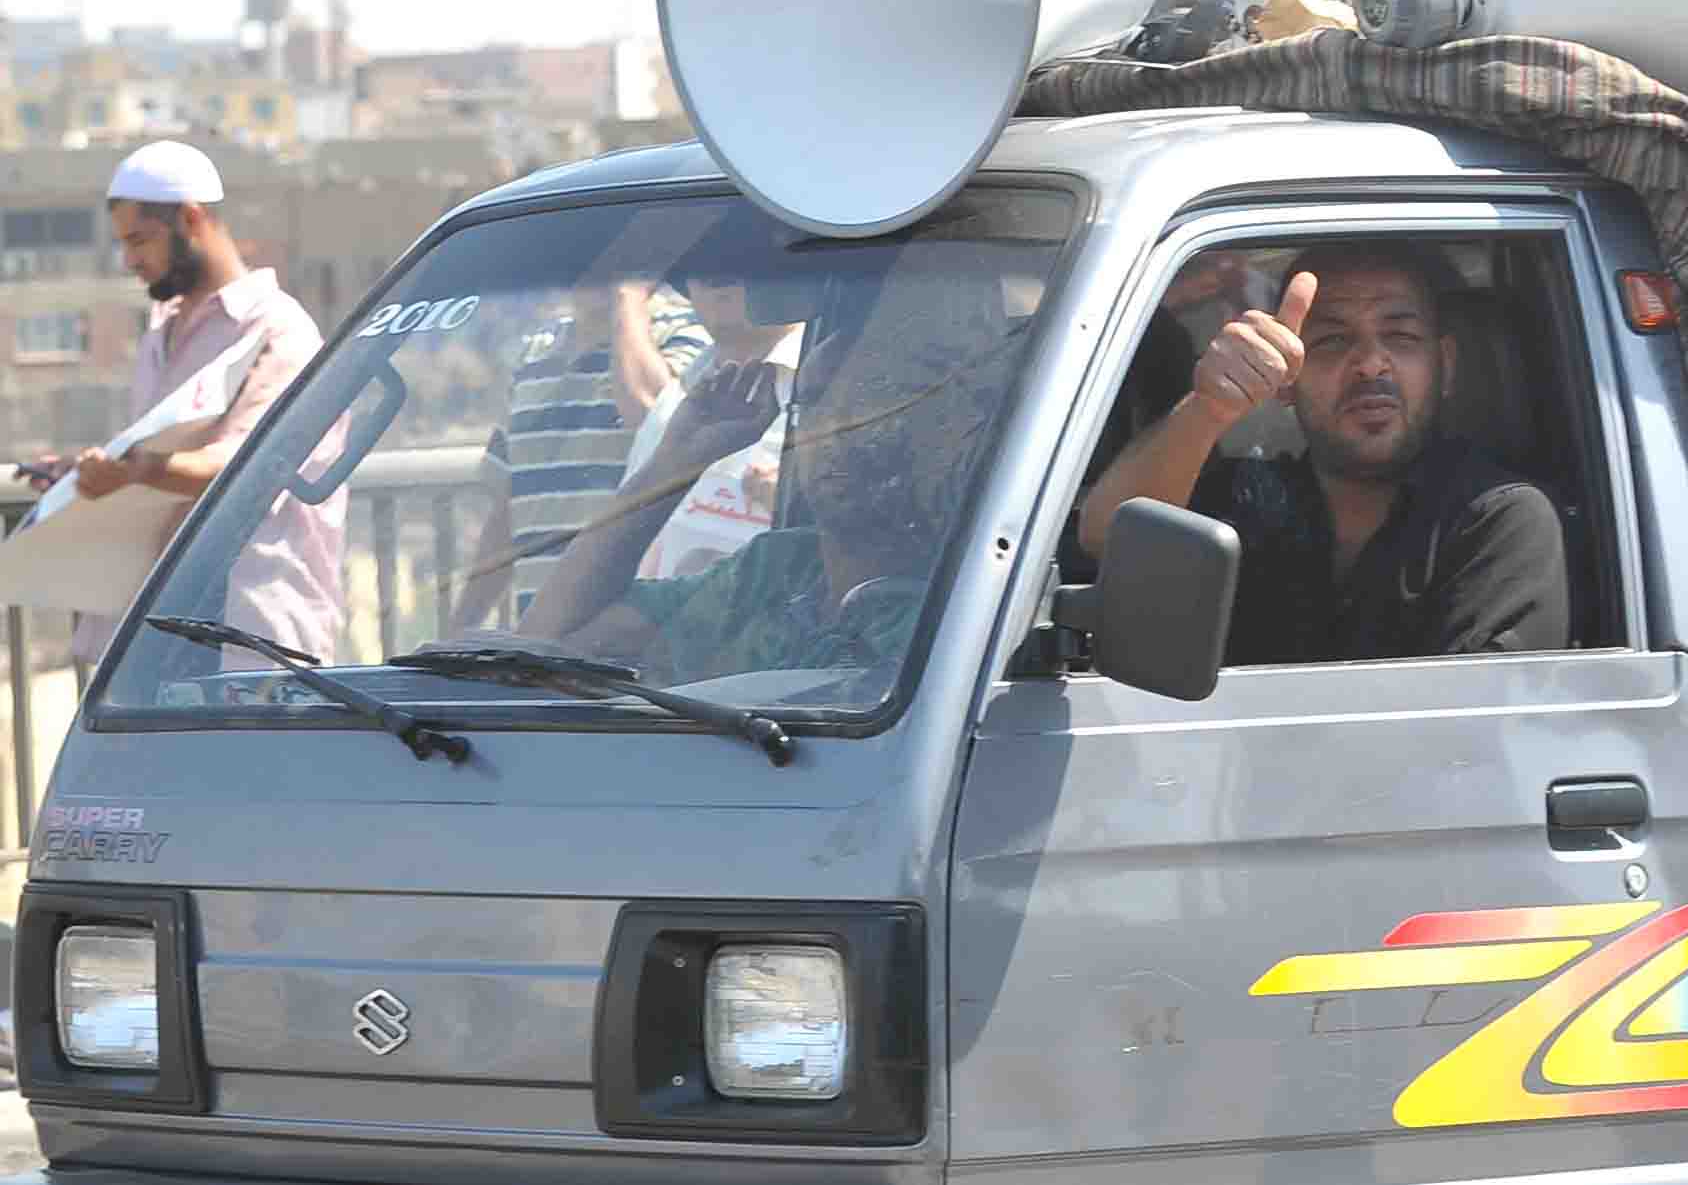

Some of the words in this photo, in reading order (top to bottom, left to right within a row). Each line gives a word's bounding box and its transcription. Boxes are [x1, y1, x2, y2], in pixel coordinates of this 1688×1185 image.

[355, 294, 480, 338] 2010
[46, 807, 145, 830] SUPER
[42, 830, 172, 863] CARRY
